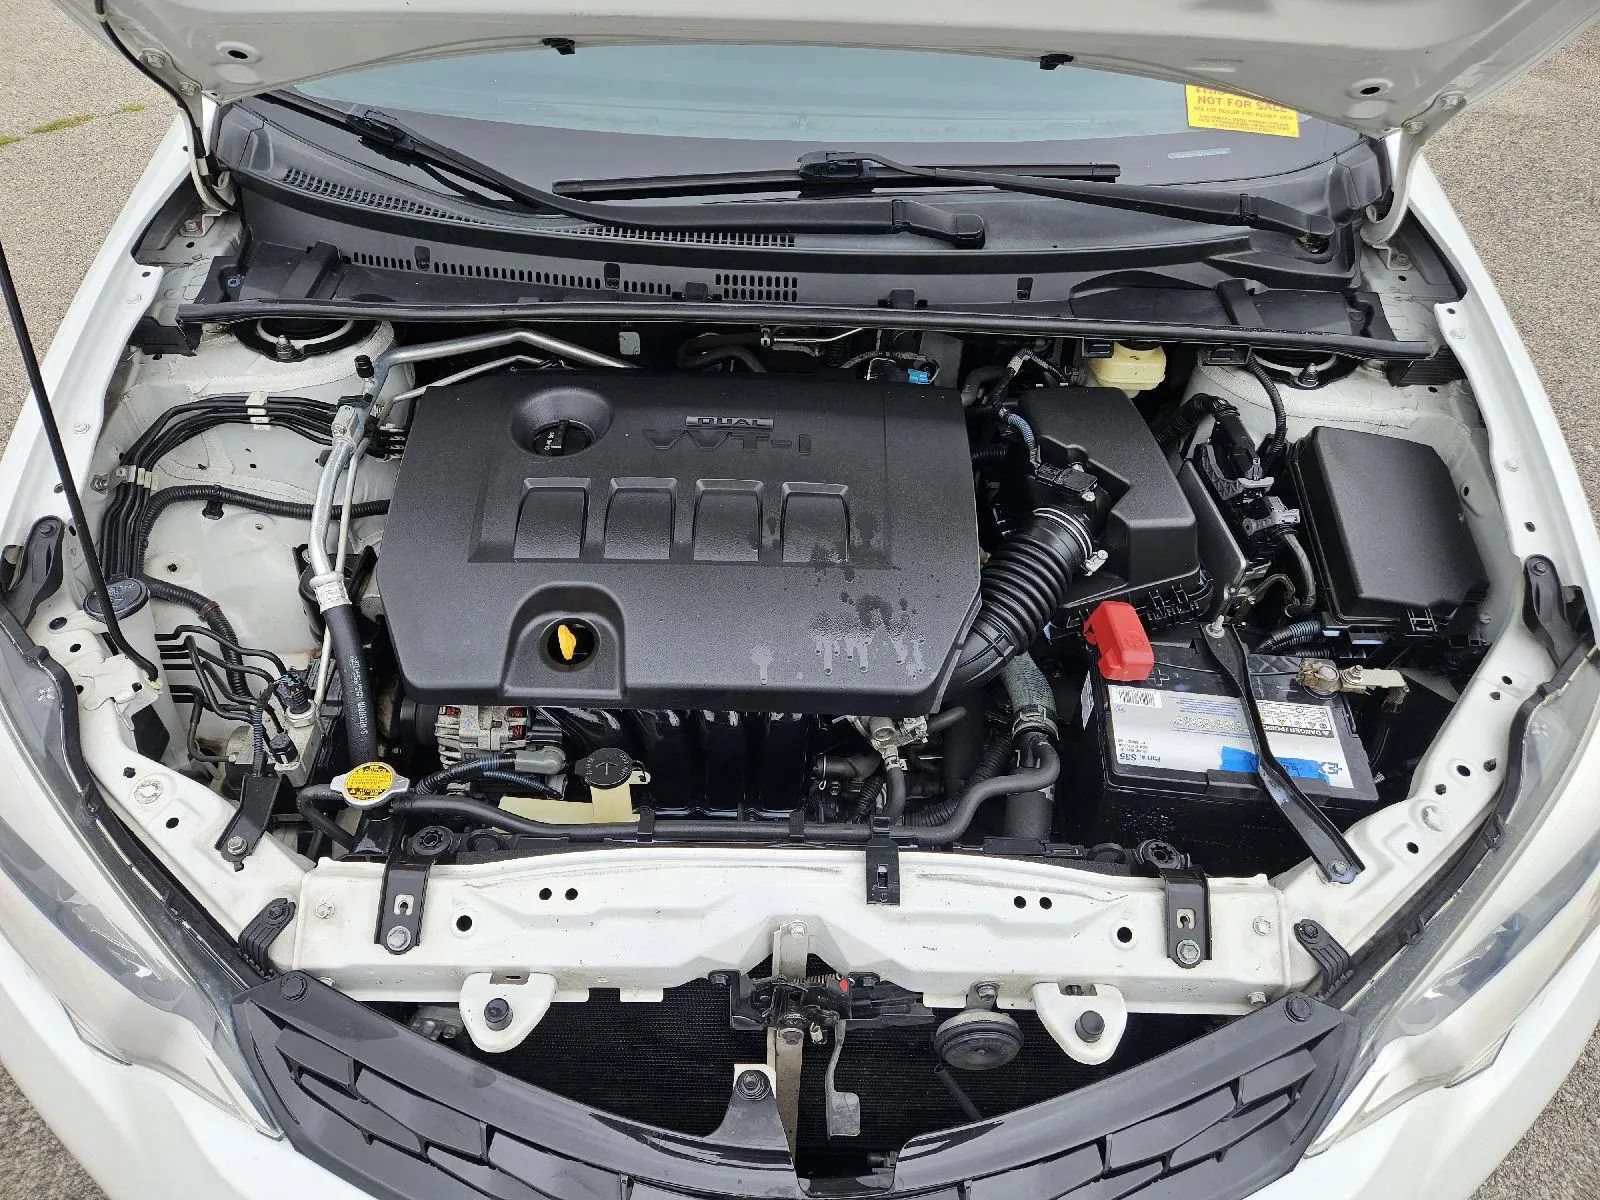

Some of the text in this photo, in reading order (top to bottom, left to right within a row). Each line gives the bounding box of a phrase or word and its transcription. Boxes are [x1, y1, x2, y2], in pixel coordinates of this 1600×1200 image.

[1197, 95, 1288, 113] NOT FOR SALE
[697, 416, 767, 427] DUAL
[1289, 726, 1322, 737] DANGER
[1119, 752, 1137, 761] S35
